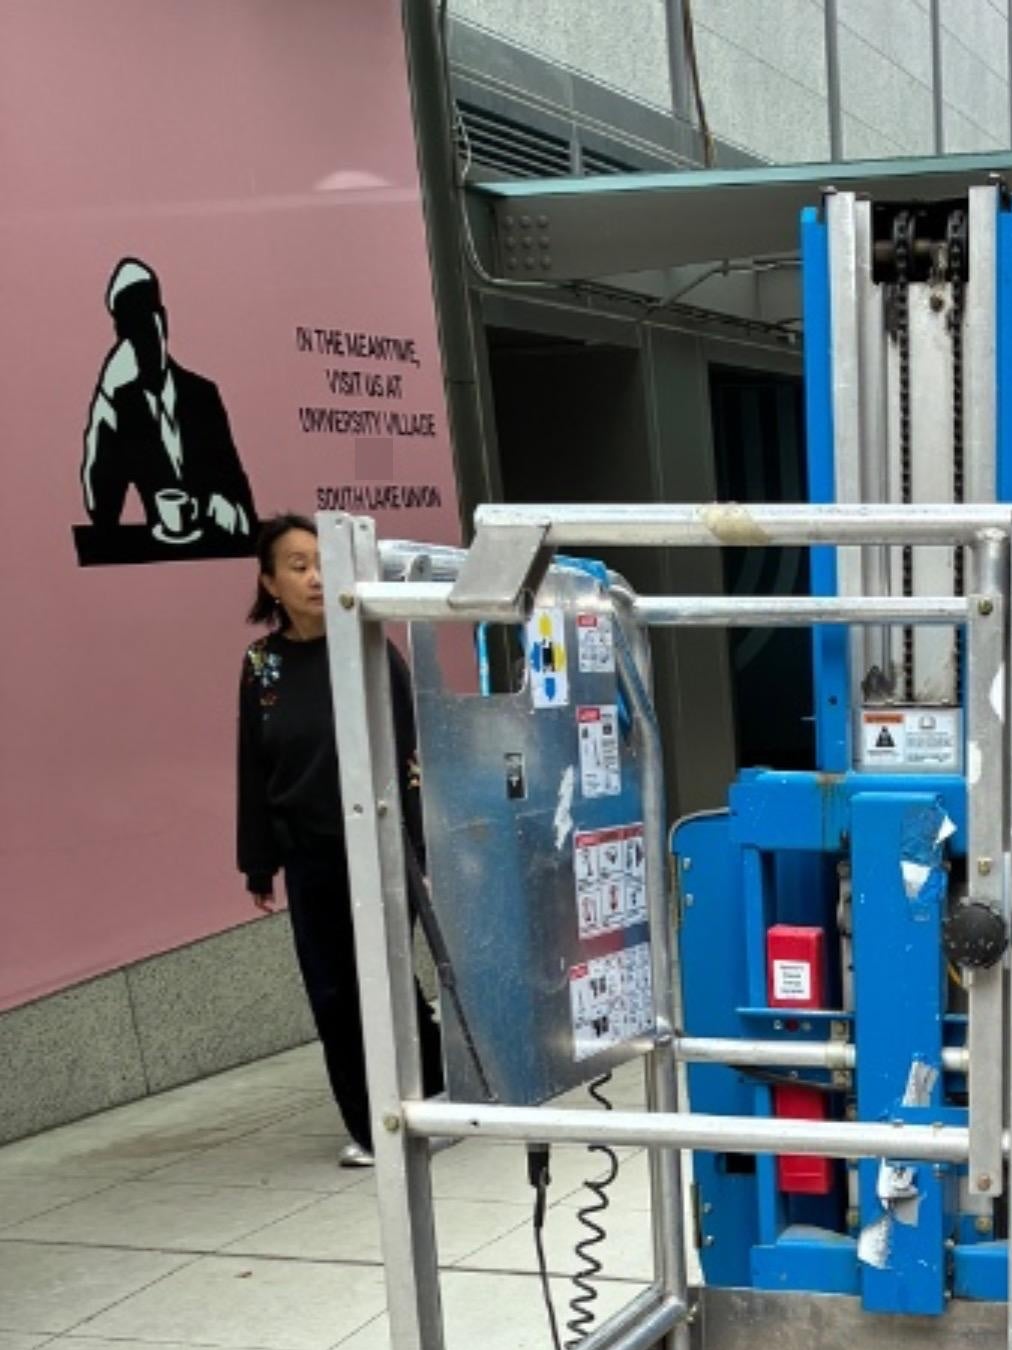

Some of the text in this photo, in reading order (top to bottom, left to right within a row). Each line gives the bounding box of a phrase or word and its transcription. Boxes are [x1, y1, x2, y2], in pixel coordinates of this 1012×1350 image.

[296, 326, 420, 368] IN THE MEANTIME,
[326, 369, 402, 399] VISIT US AT
[299, 407, 436, 438] UNIVERSITY VILLAGE
[316, 485, 442, 511] SOUTH LAKE UNION
